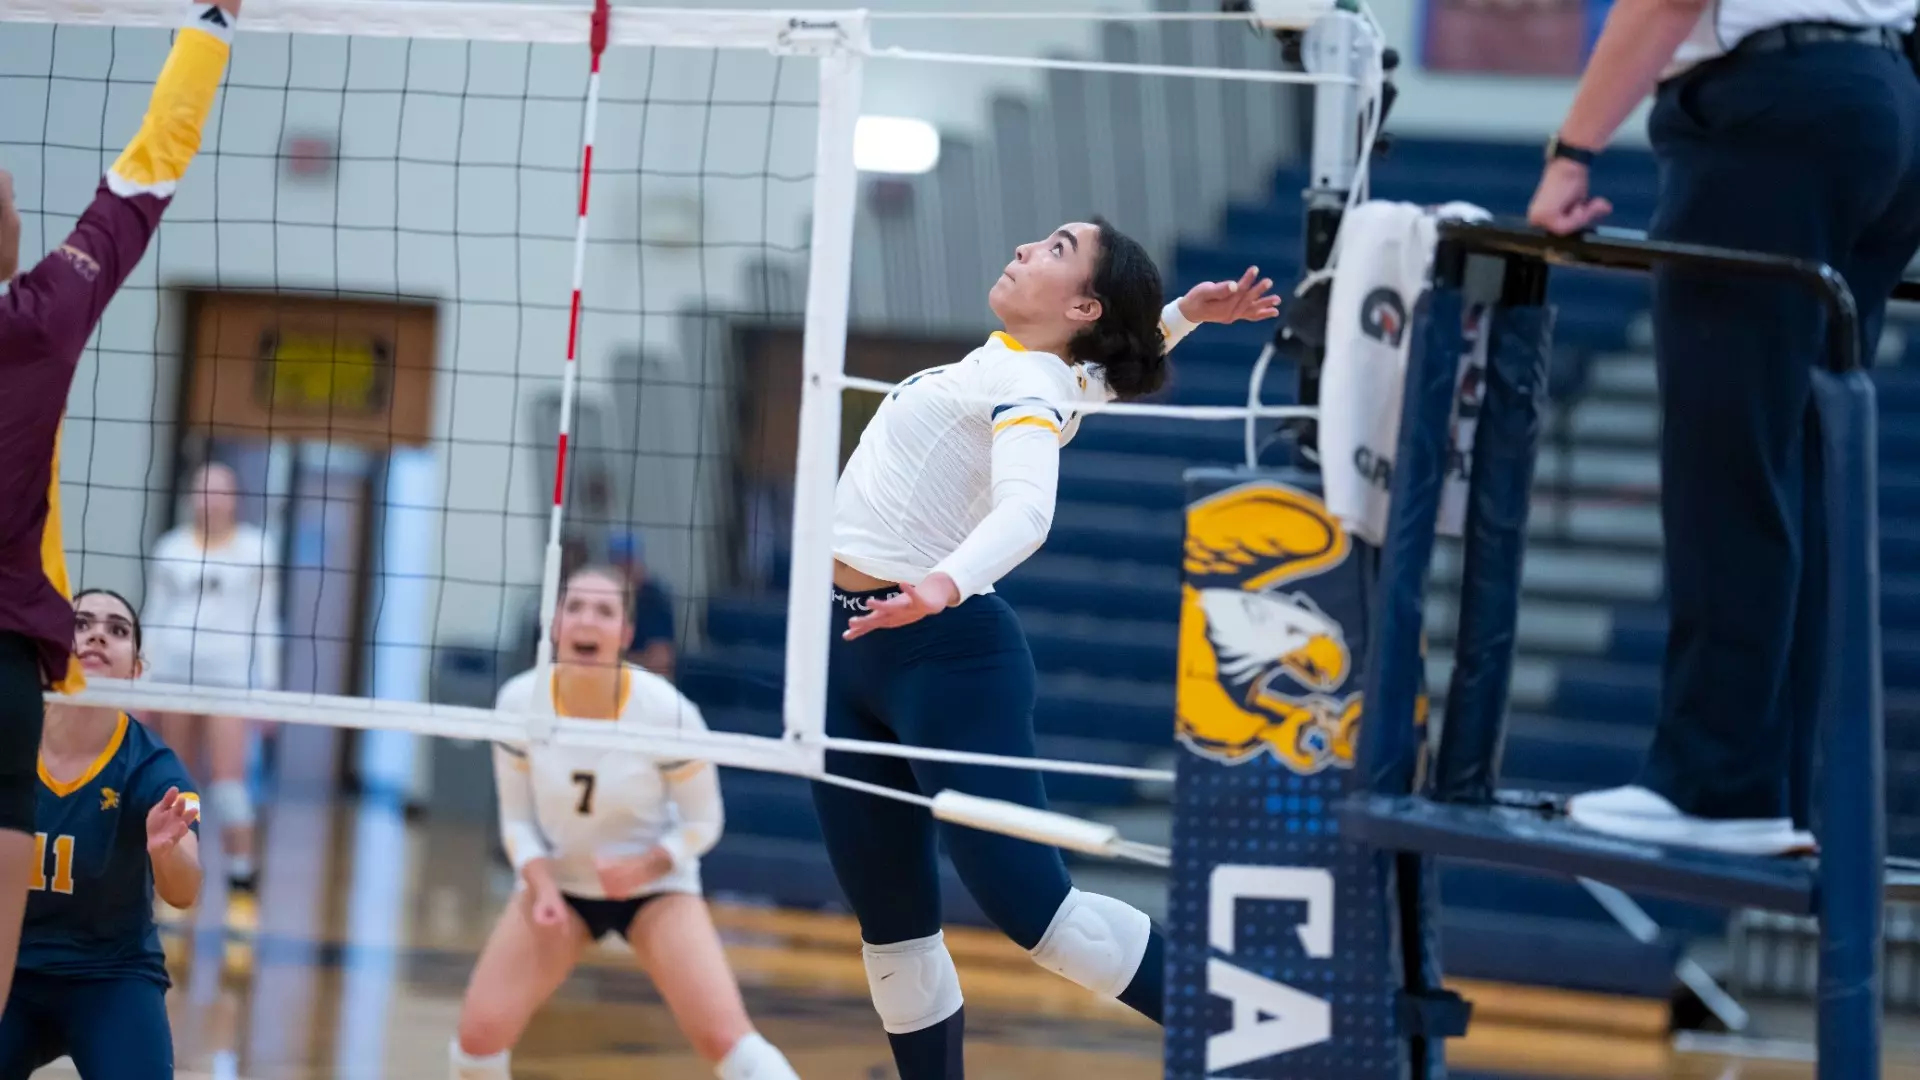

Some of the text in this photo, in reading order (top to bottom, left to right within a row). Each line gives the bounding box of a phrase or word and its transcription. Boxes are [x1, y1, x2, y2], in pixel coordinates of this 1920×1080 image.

[569, 769, 597, 816] 7
[26, 831, 76, 895] 11
[1205, 863, 1335, 1080] CA
